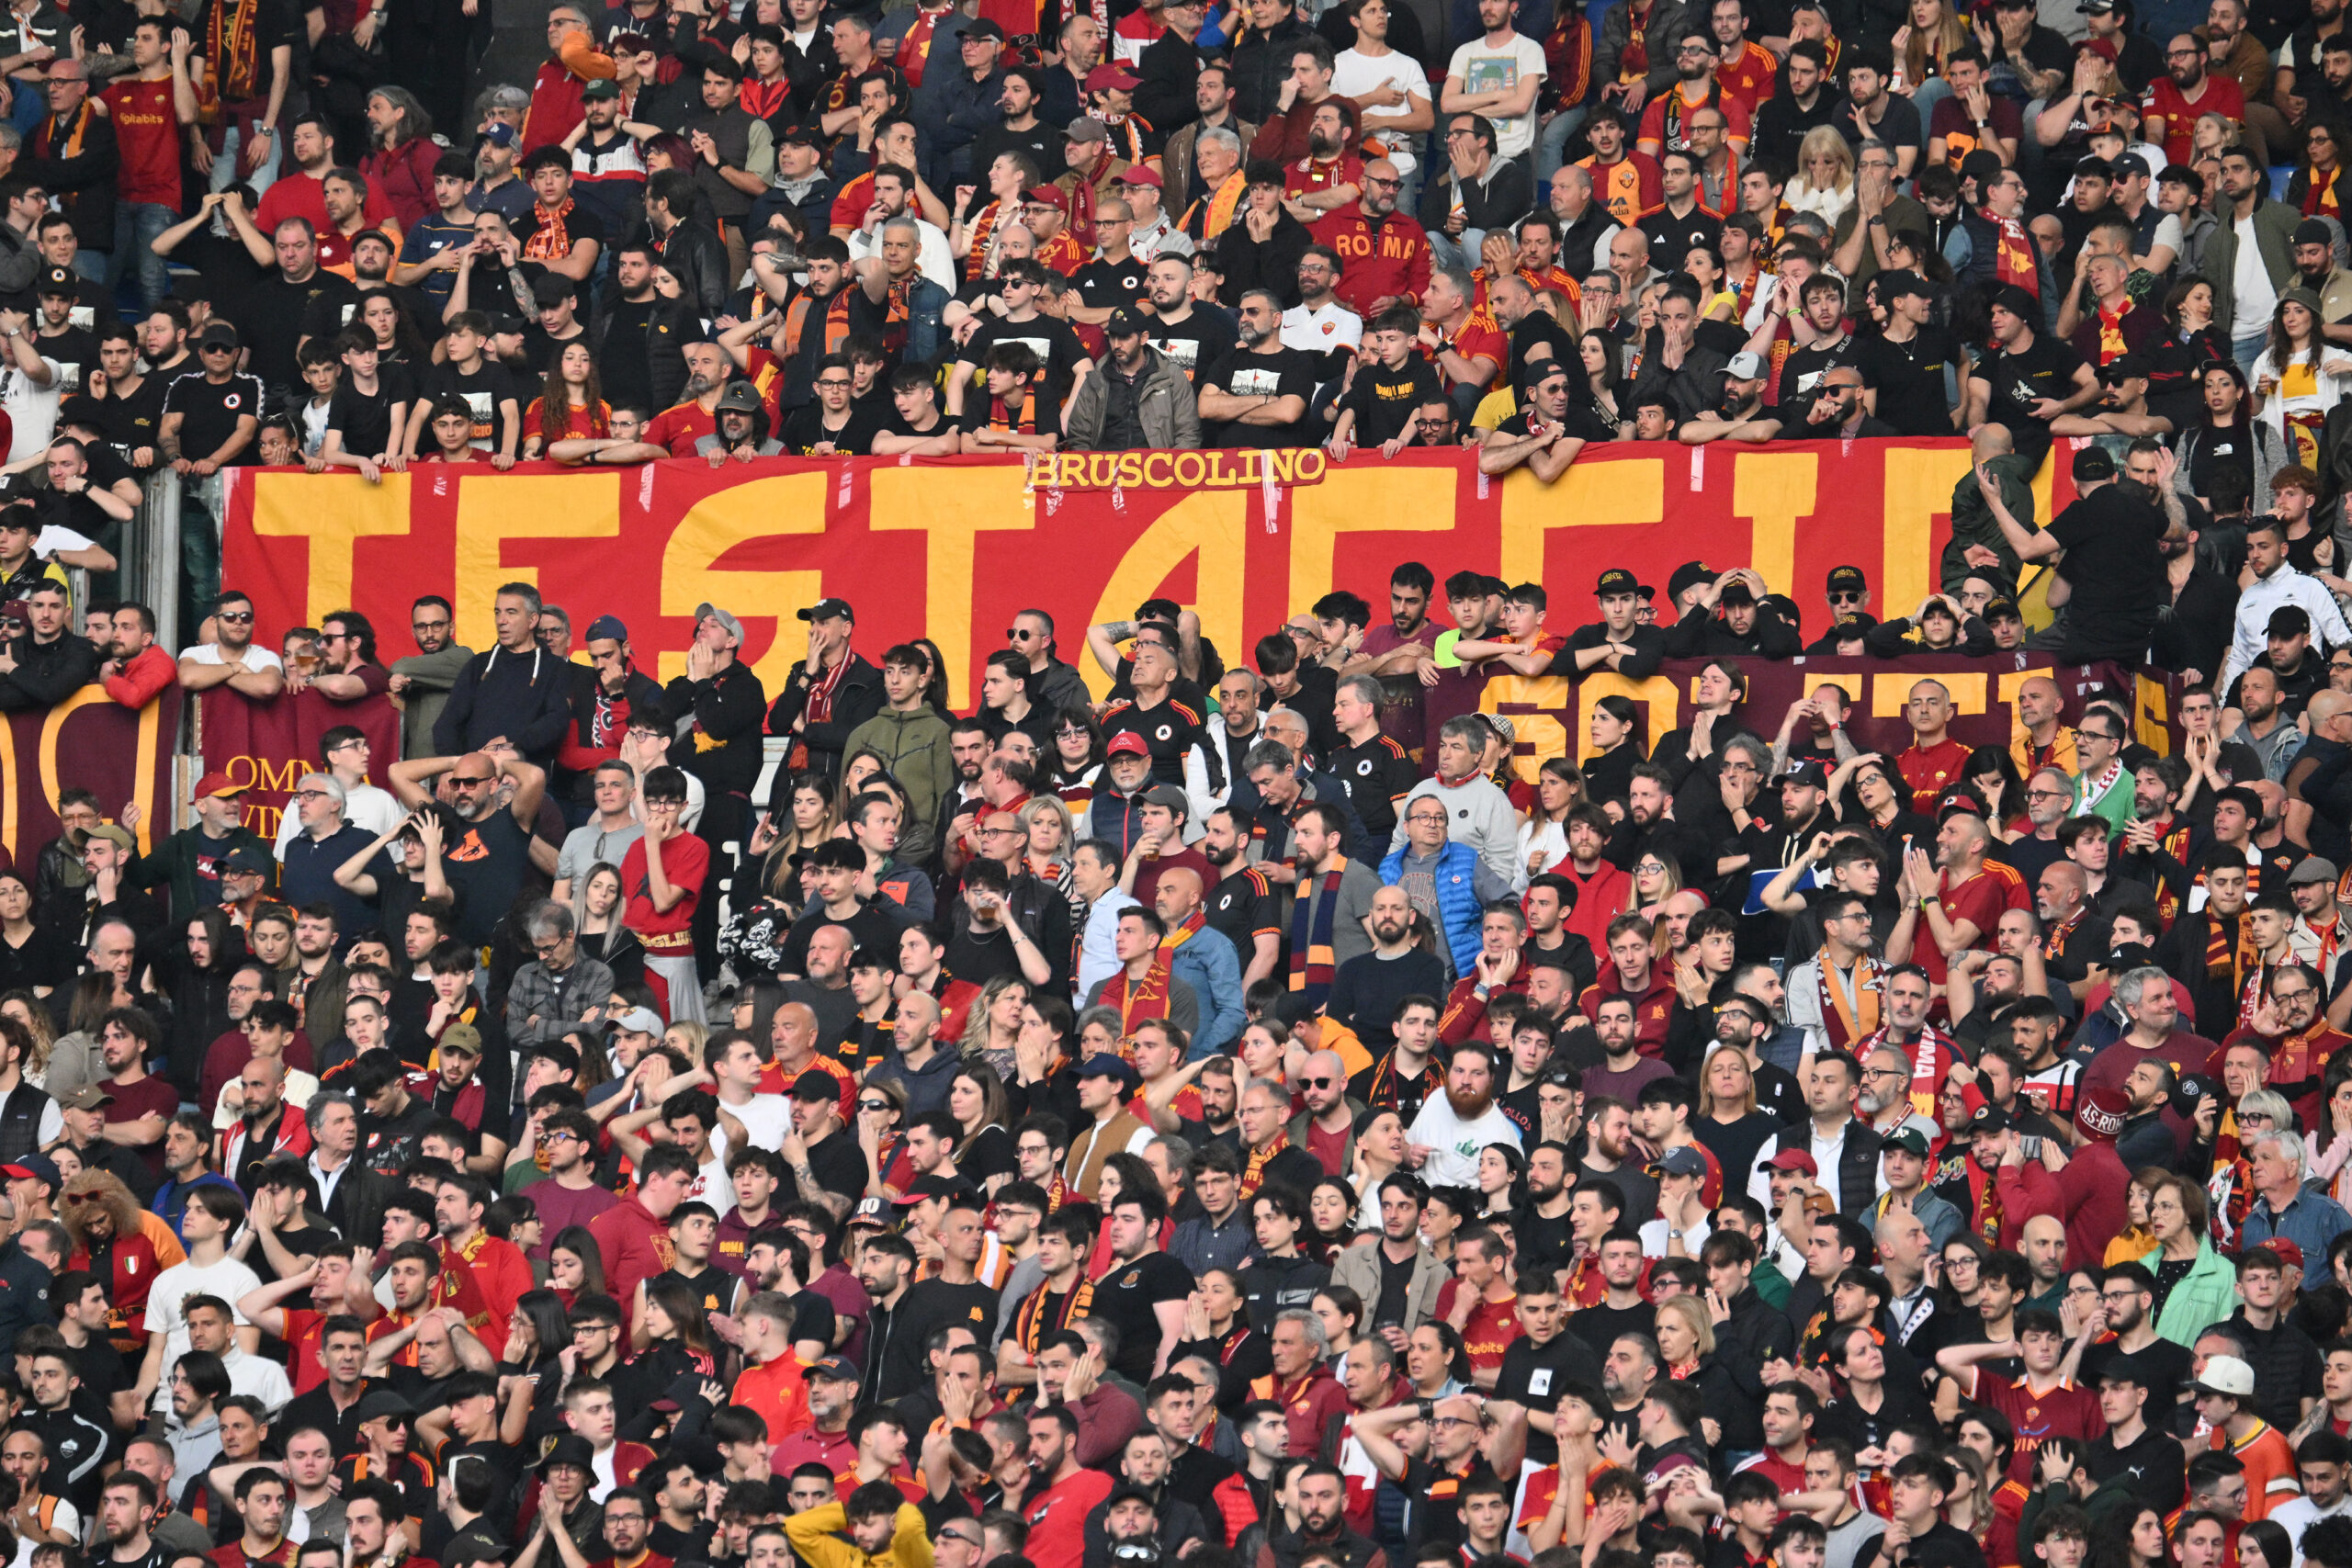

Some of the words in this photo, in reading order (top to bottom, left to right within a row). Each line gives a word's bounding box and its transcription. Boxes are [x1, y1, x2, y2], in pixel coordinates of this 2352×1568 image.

[1336, 234, 1415, 260] ROMA
[2012, 388, 2028, 403] BOY
[1031, 447, 1326, 488] BRUSCOLINO
[857, 1197, 880, 1213] 10
[718, 1241, 744, 1254] ROMA
